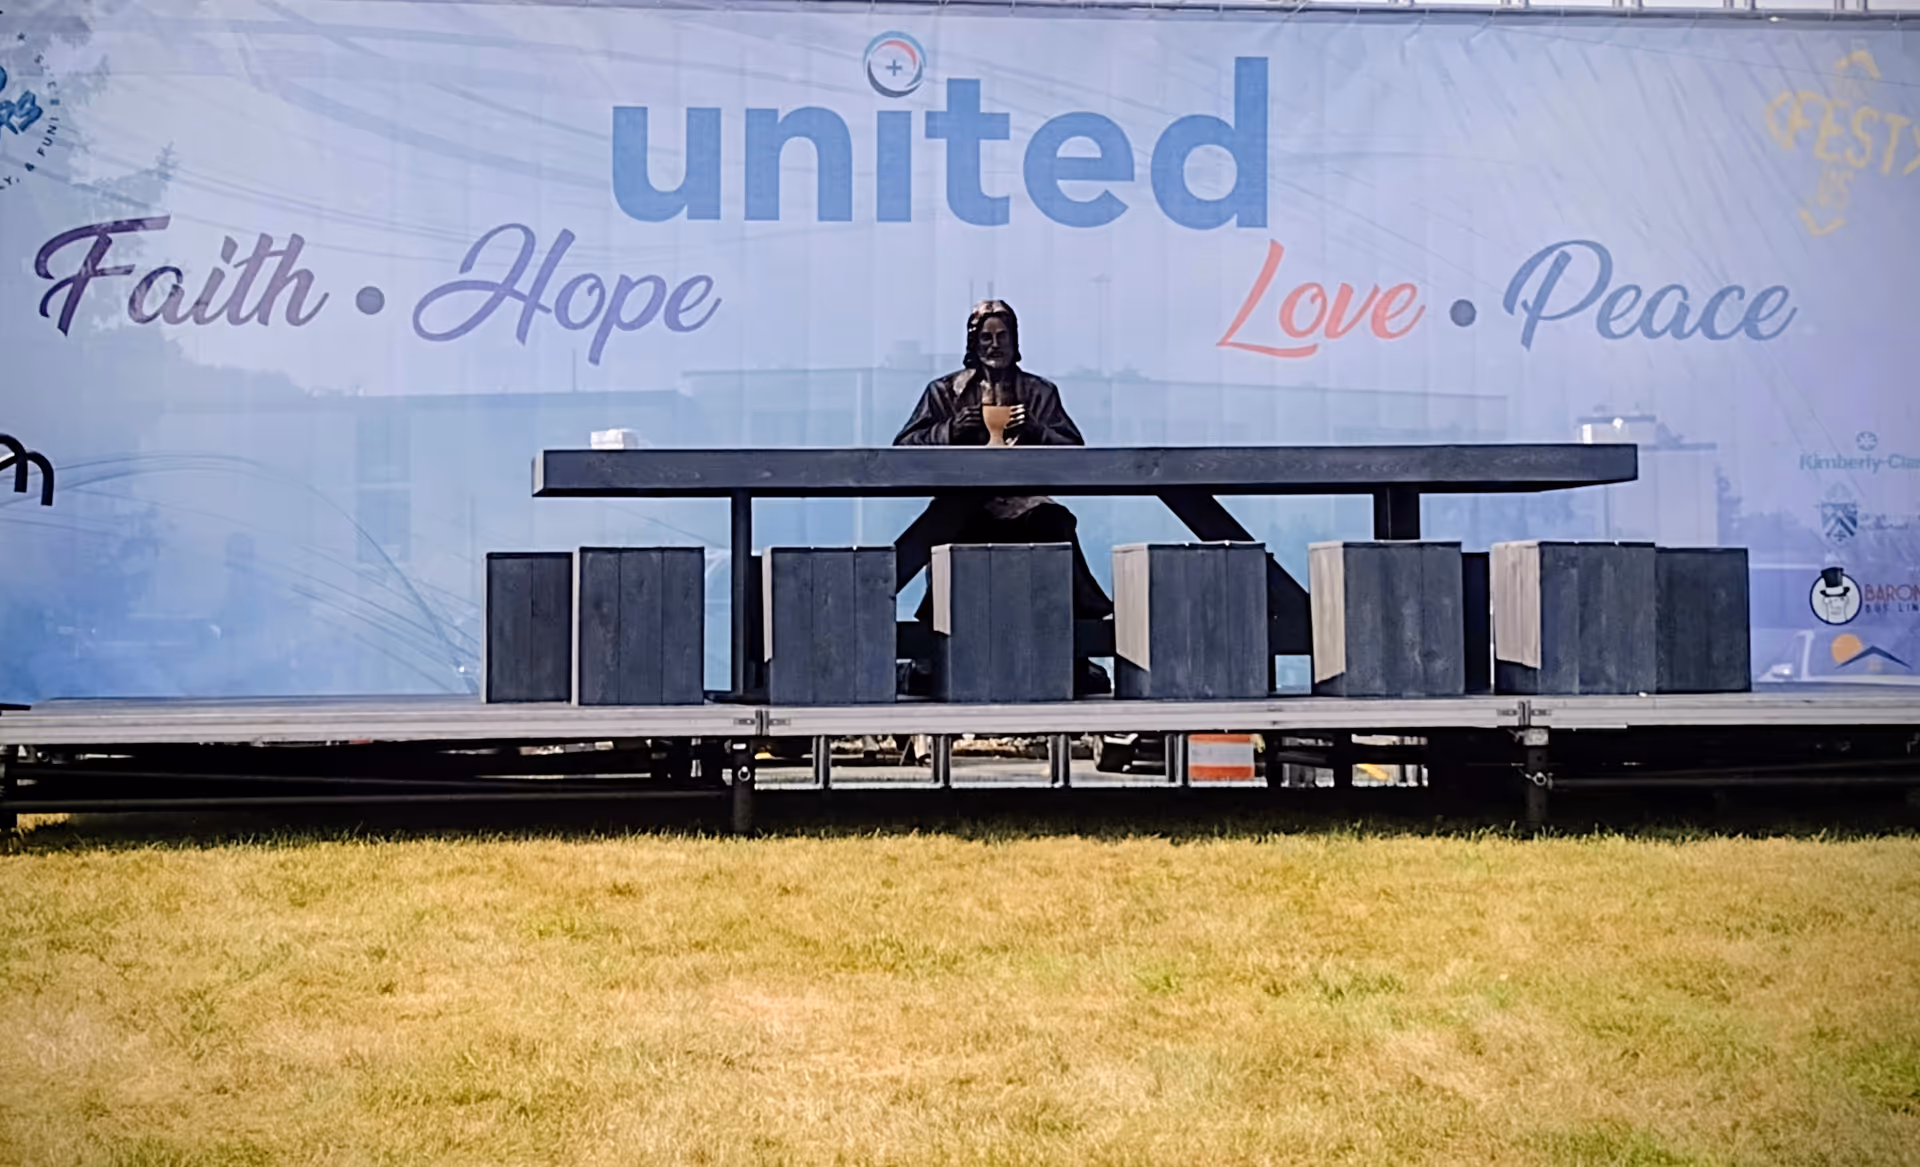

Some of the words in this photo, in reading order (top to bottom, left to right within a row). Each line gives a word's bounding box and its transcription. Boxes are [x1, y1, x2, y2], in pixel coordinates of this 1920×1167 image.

[612, 31, 1268, 229] united
[34, 215, 329, 337] Faith
[412, 223, 722, 366] Hope
[1216, 239, 1425, 357] Love
[1503, 240, 1798, 351] Peace
